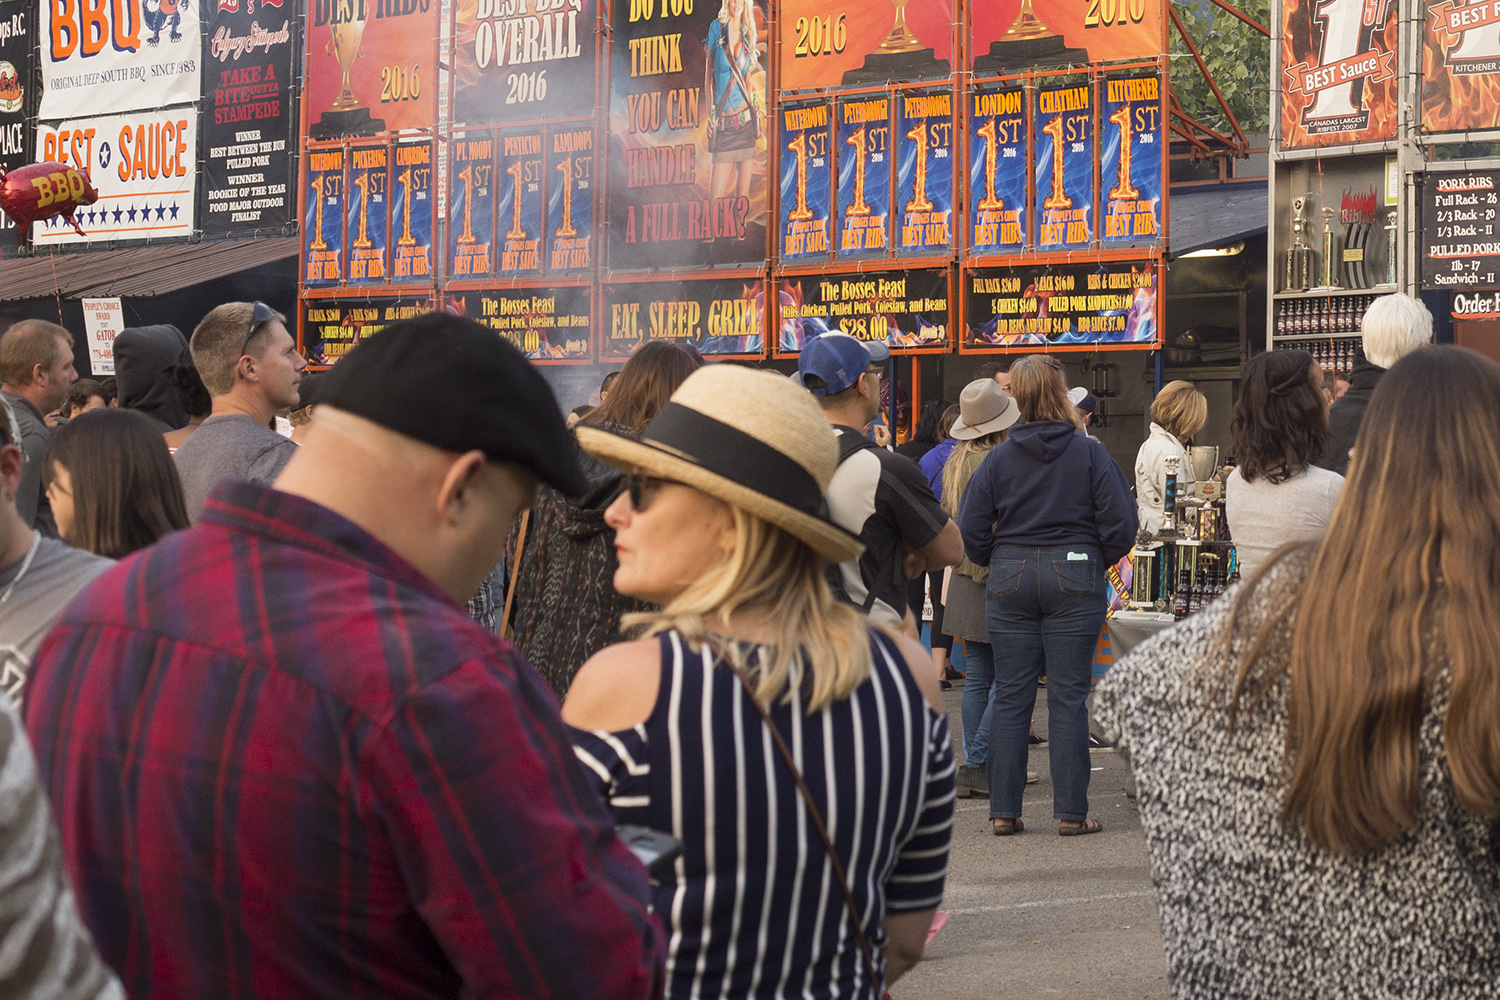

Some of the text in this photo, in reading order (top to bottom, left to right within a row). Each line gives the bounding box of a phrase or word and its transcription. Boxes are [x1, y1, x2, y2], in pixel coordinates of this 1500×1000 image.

[1450, 6, 1489, 28] BEST
[475, 10, 581, 69] OVERALL
[630, 34, 682, 77] THINK
[1455, 63, 1497, 72] KITCHENER
[221, 64, 276, 87] TAKE A
[506, 69, 547, 104] 2016
[1040, 87, 1089, 114] CHATHAM
[1108, 77, 1159, 102] KITCHENER
[214, 100, 280, 124] STAMPEDE
[627, 87, 700, 134] YOU CAN
[974, 92, 1022, 117] LONDON
[44, 119, 188, 182] BEST SAUCE
[31, 169, 85, 208] BBQ
[1438, 177, 1493, 191] PORK RIBS
[1430, 244, 1471, 257] PULLED
[820, 277, 906, 302] The Bosses Feast
[1454, 293, 1493, 315] Order
[611, 298, 760, 340] EAT, SLEEP, GRILL
[96, 329, 116, 341] GATOR
